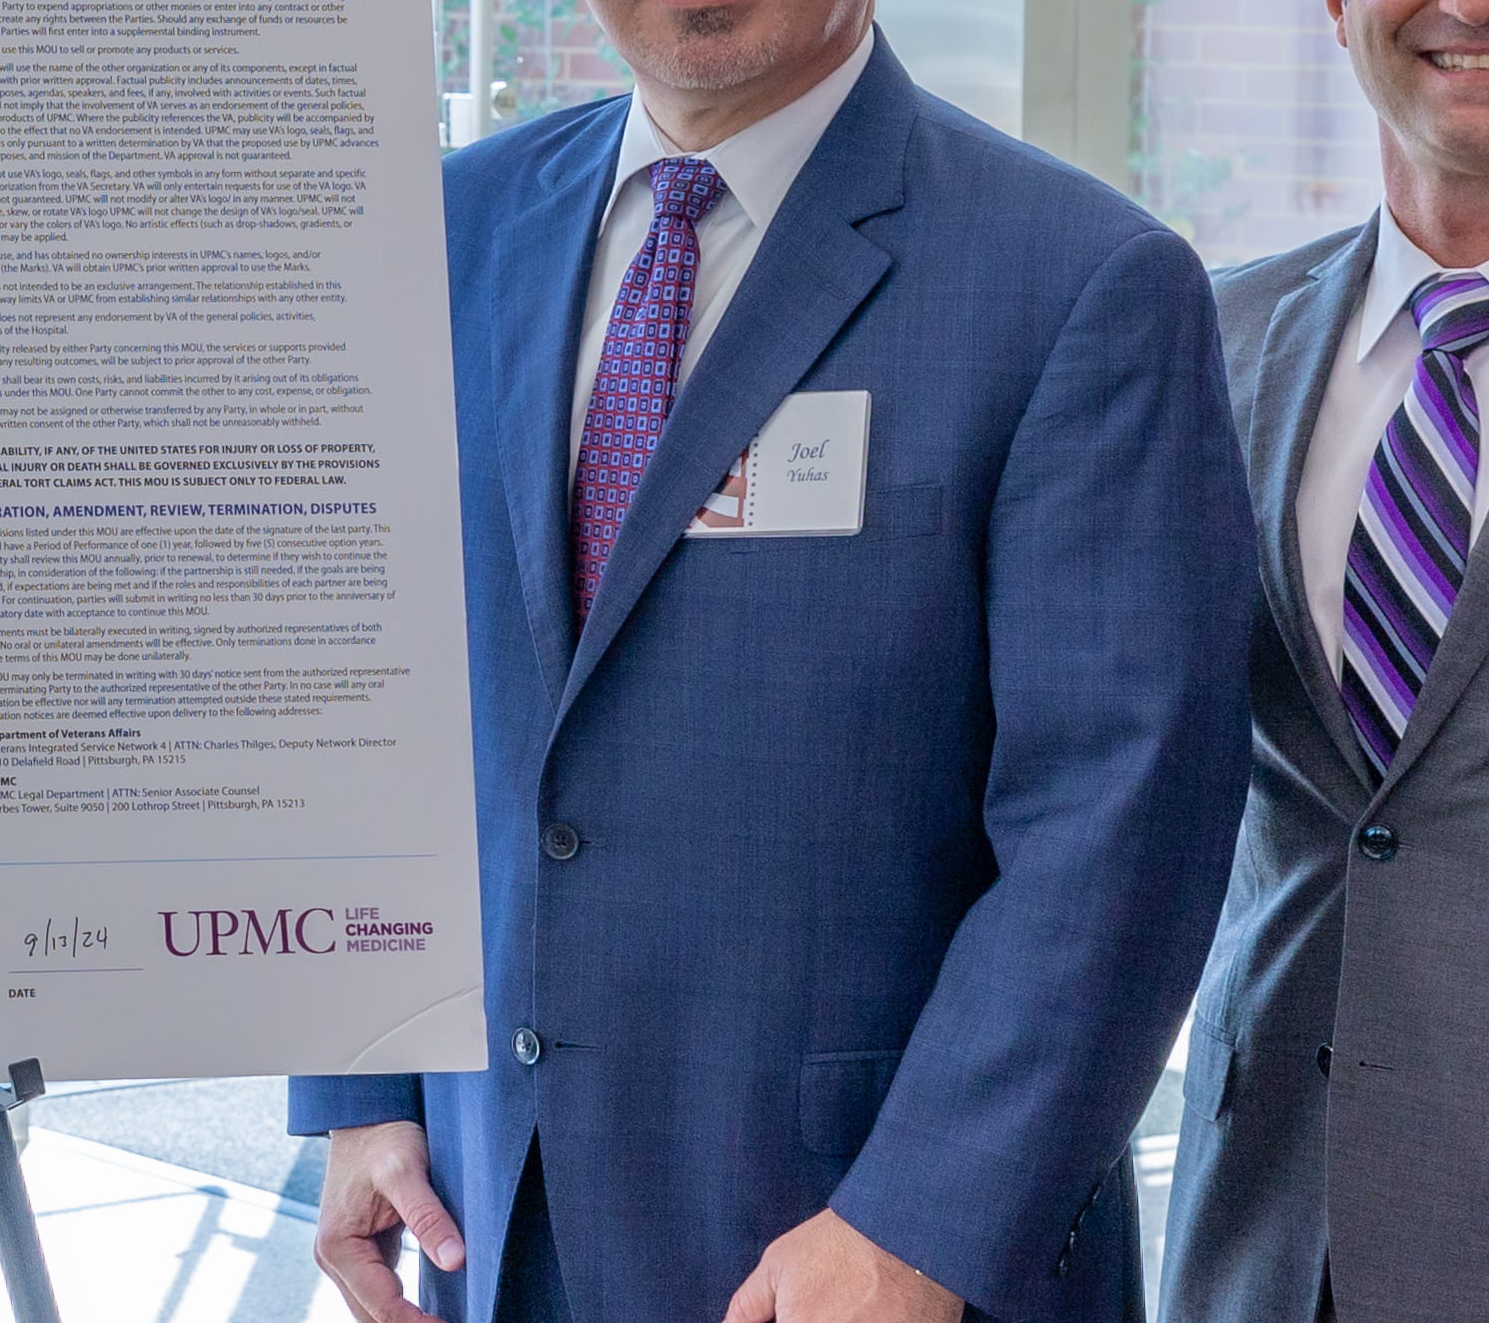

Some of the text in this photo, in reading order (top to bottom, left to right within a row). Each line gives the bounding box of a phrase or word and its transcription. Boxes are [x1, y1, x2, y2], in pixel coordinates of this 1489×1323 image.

[787, 439, 830, 462] Joel
[787, 468, 830, 482] Yuhas
[52, 504, 147, 518] AMENDMENT,
[150, 503, 206, 517] REVIEW,
[207, 502, 307, 516] TERMINATION,
[310, 502, 377, 514] DISPUTES
[344, 906, 380, 920] LIFE
[157, 907, 336, 957] UPMC
[345, 921, 433, 936] CHANGING
[23, 916, 108, 958] 9/13/24
[346, 937, 426, 952] MEDICINE
[8, 988, 36, 998] DATE
